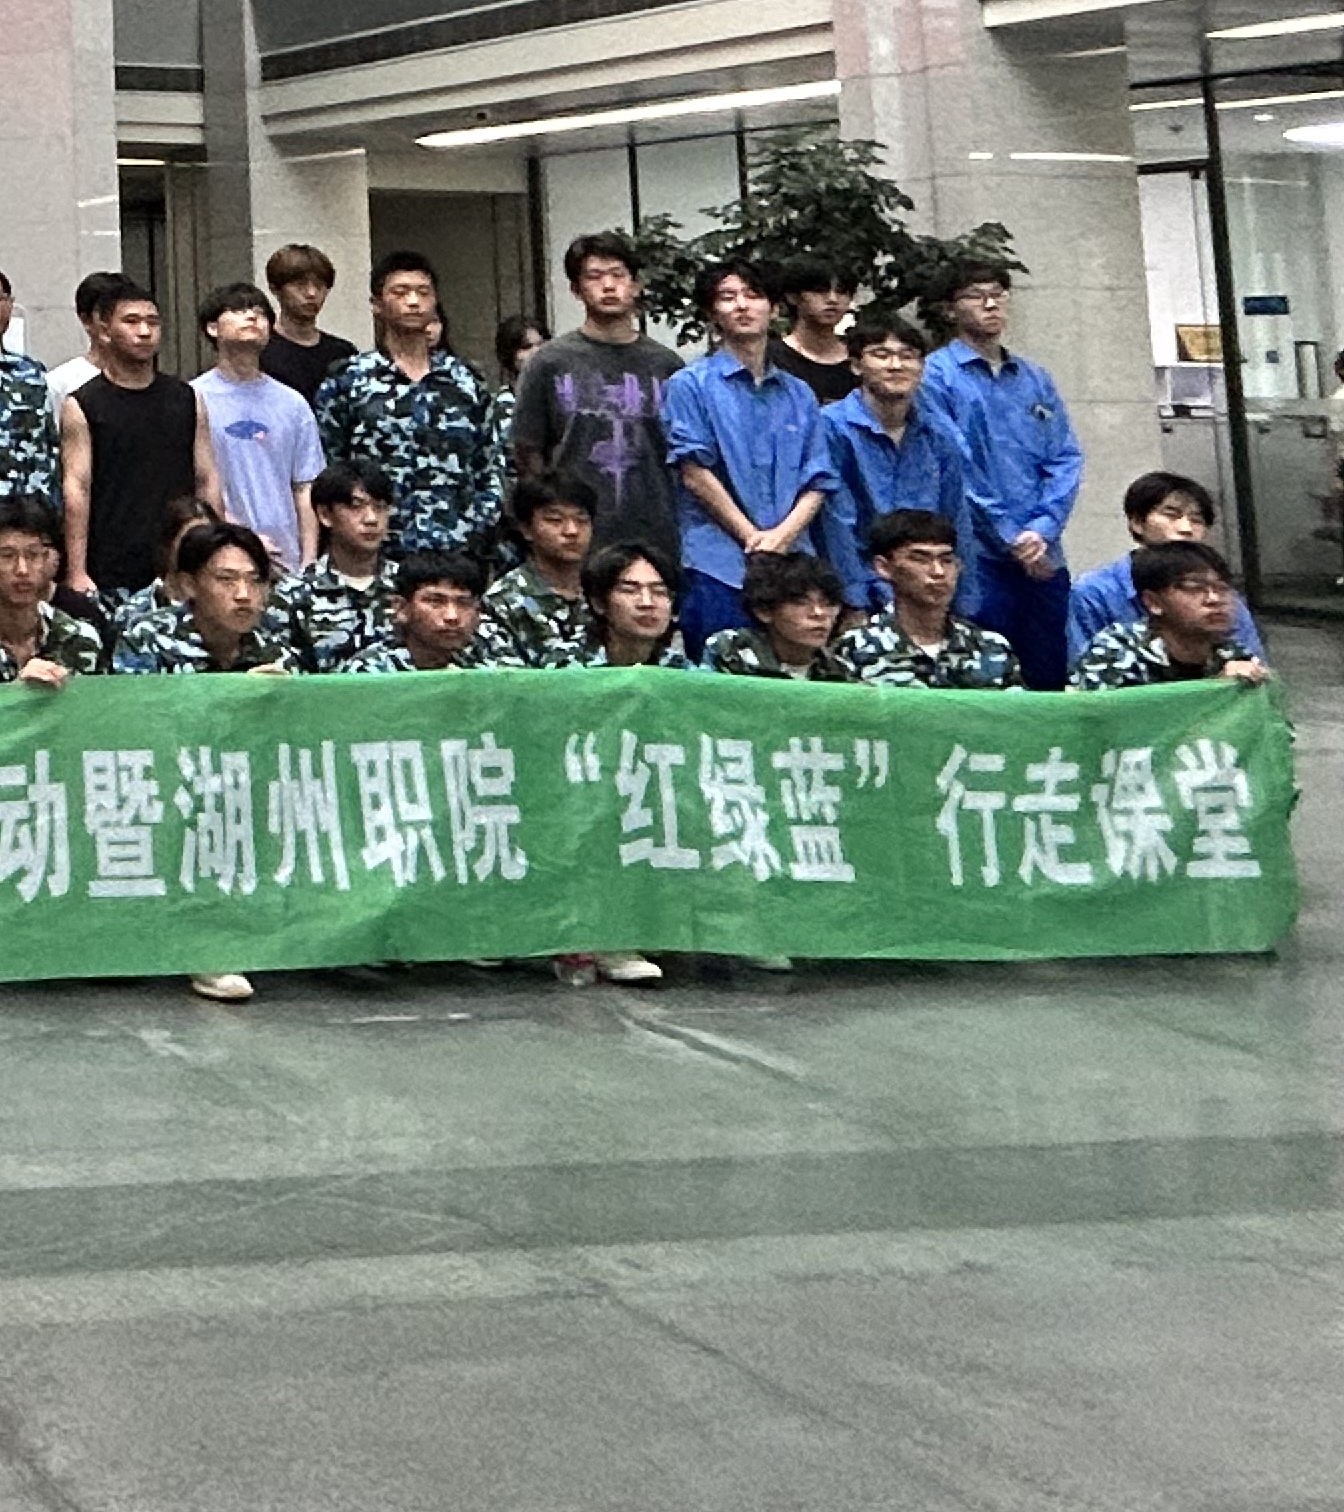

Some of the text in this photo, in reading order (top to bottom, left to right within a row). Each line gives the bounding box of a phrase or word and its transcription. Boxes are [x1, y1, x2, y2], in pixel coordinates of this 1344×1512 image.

[564, 730, 889, 883] “红绿蓝”
[936, 738, 1262, 888] 行走课堂
